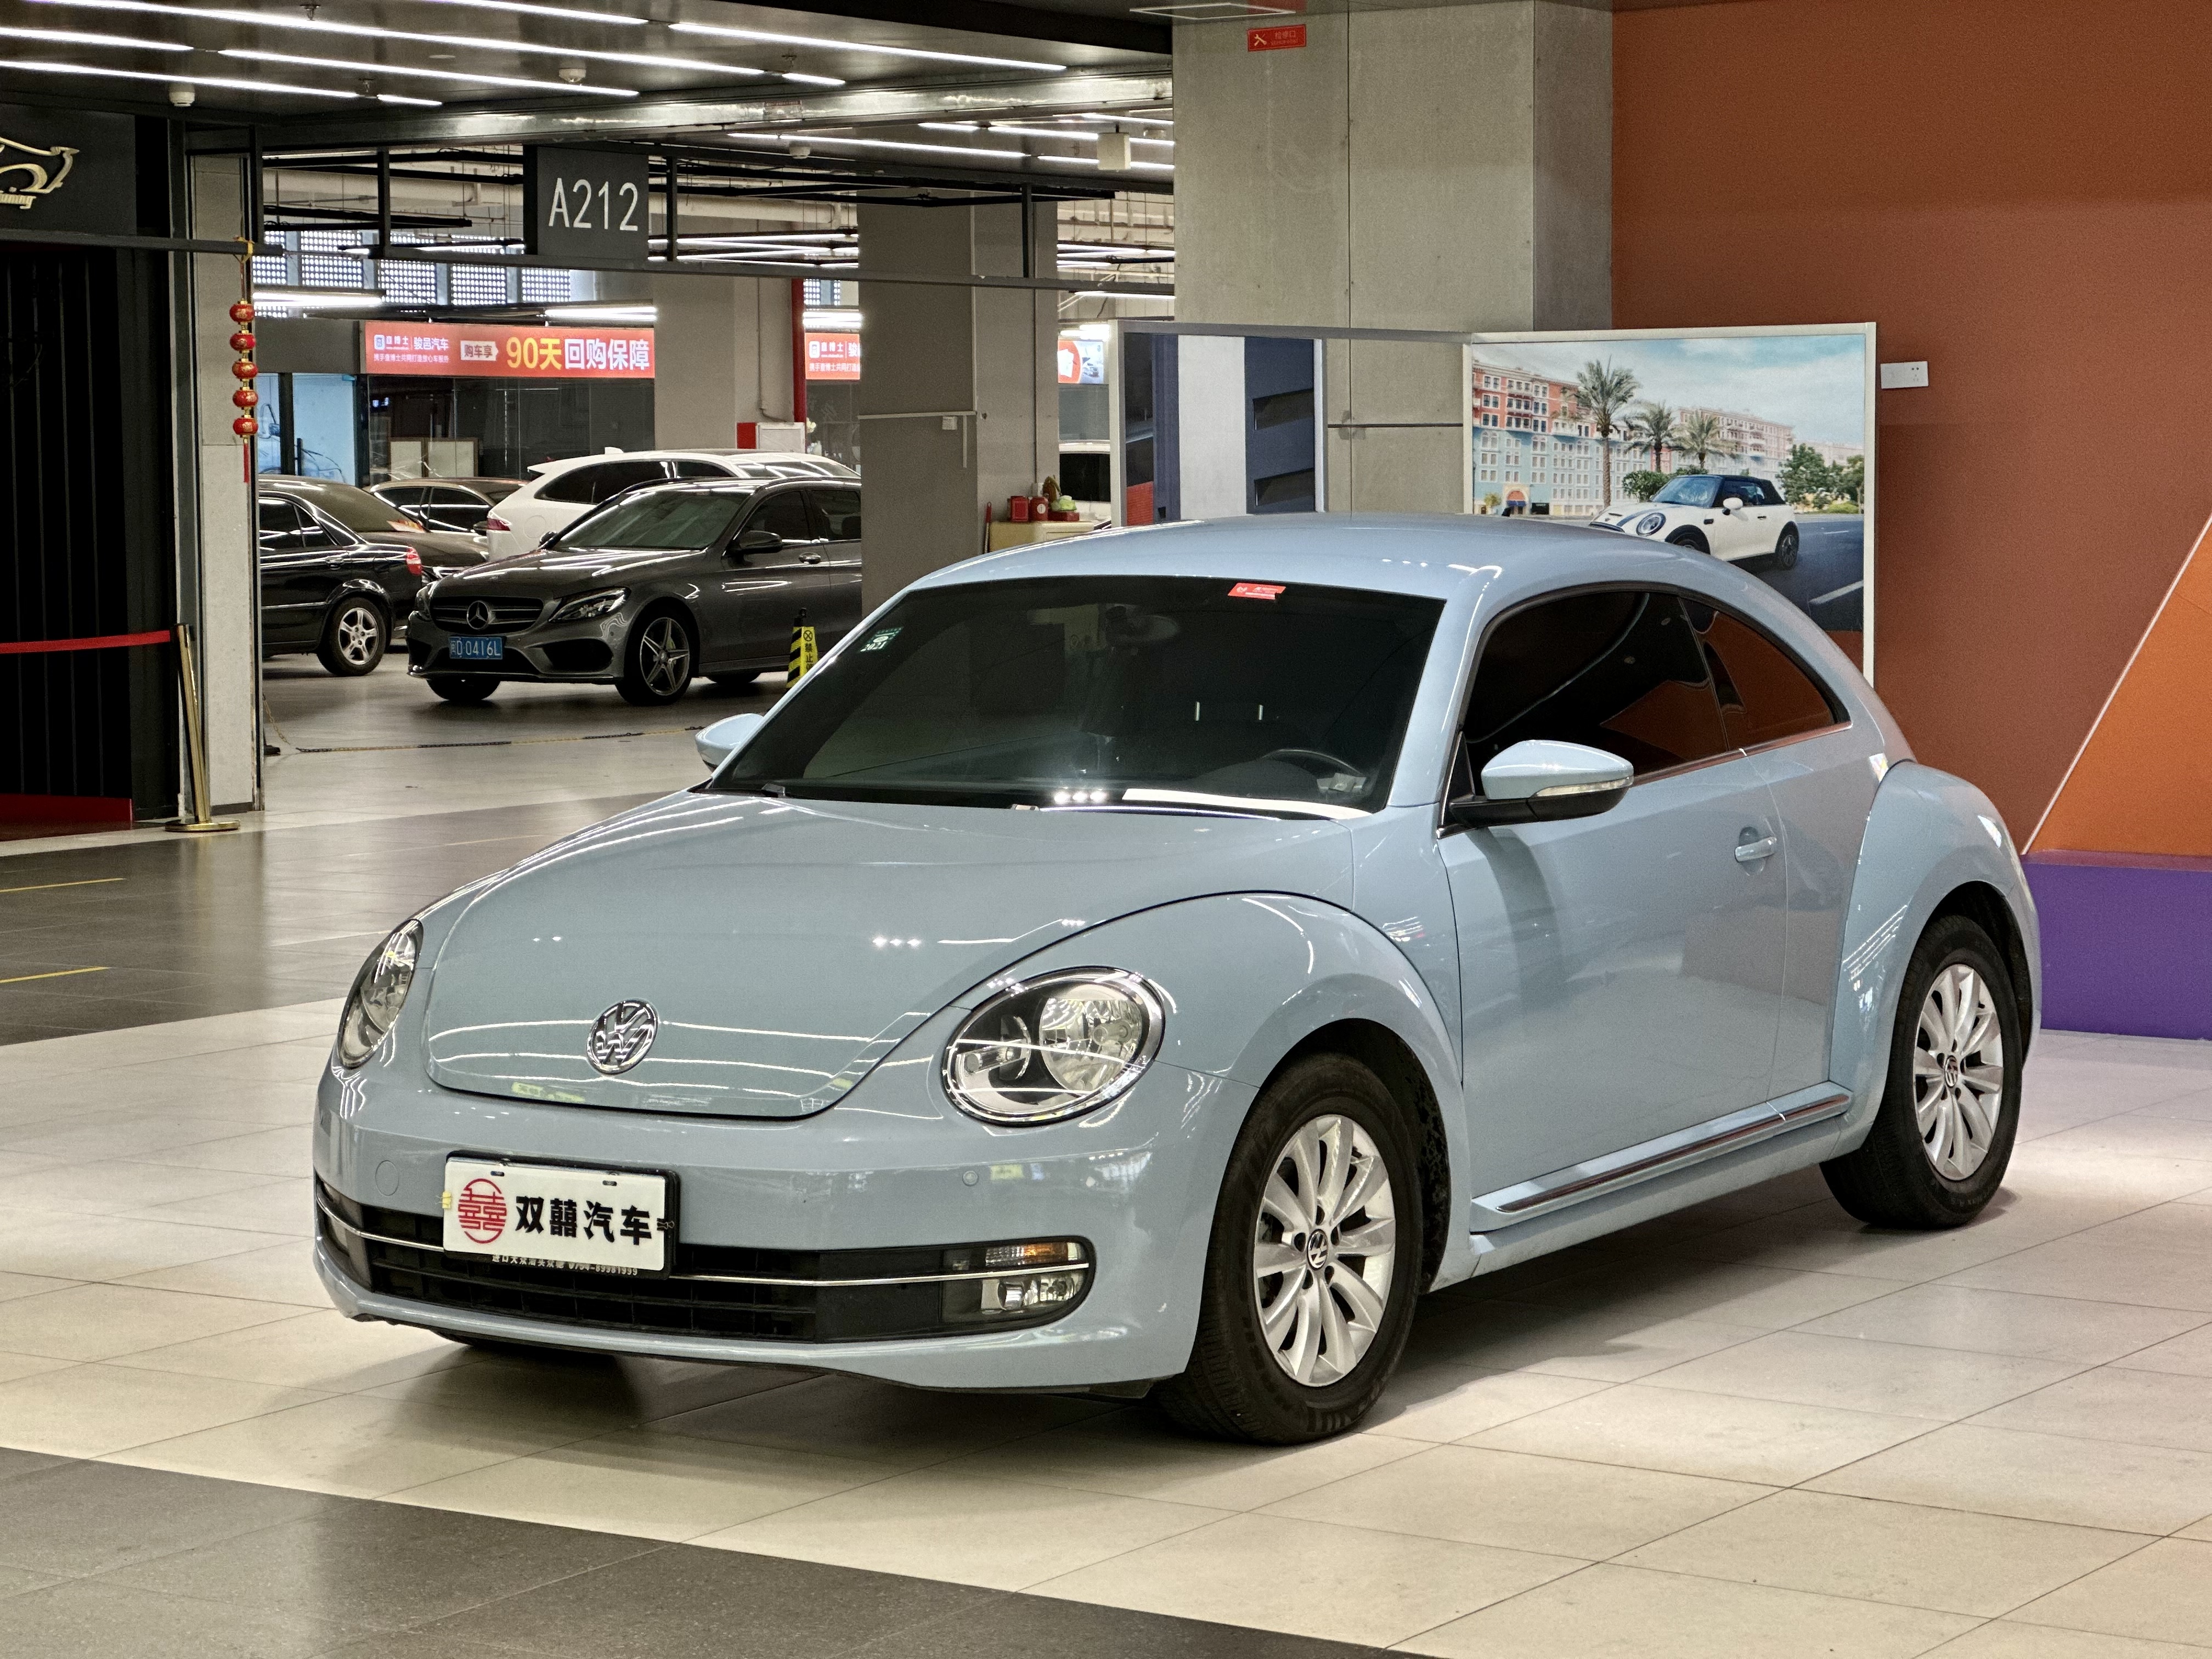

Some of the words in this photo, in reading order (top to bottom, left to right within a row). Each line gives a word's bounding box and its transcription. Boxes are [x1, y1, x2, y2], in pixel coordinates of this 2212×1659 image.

[549, 177, 638, 232] A212
[414, 337, 449, 351] 骏邑汽车
[464, 344, 493, 358] 购车享
[506, 336, 650, 371] 90天回购保障
[515, 1195, 652, 1246] 双囍汽车
